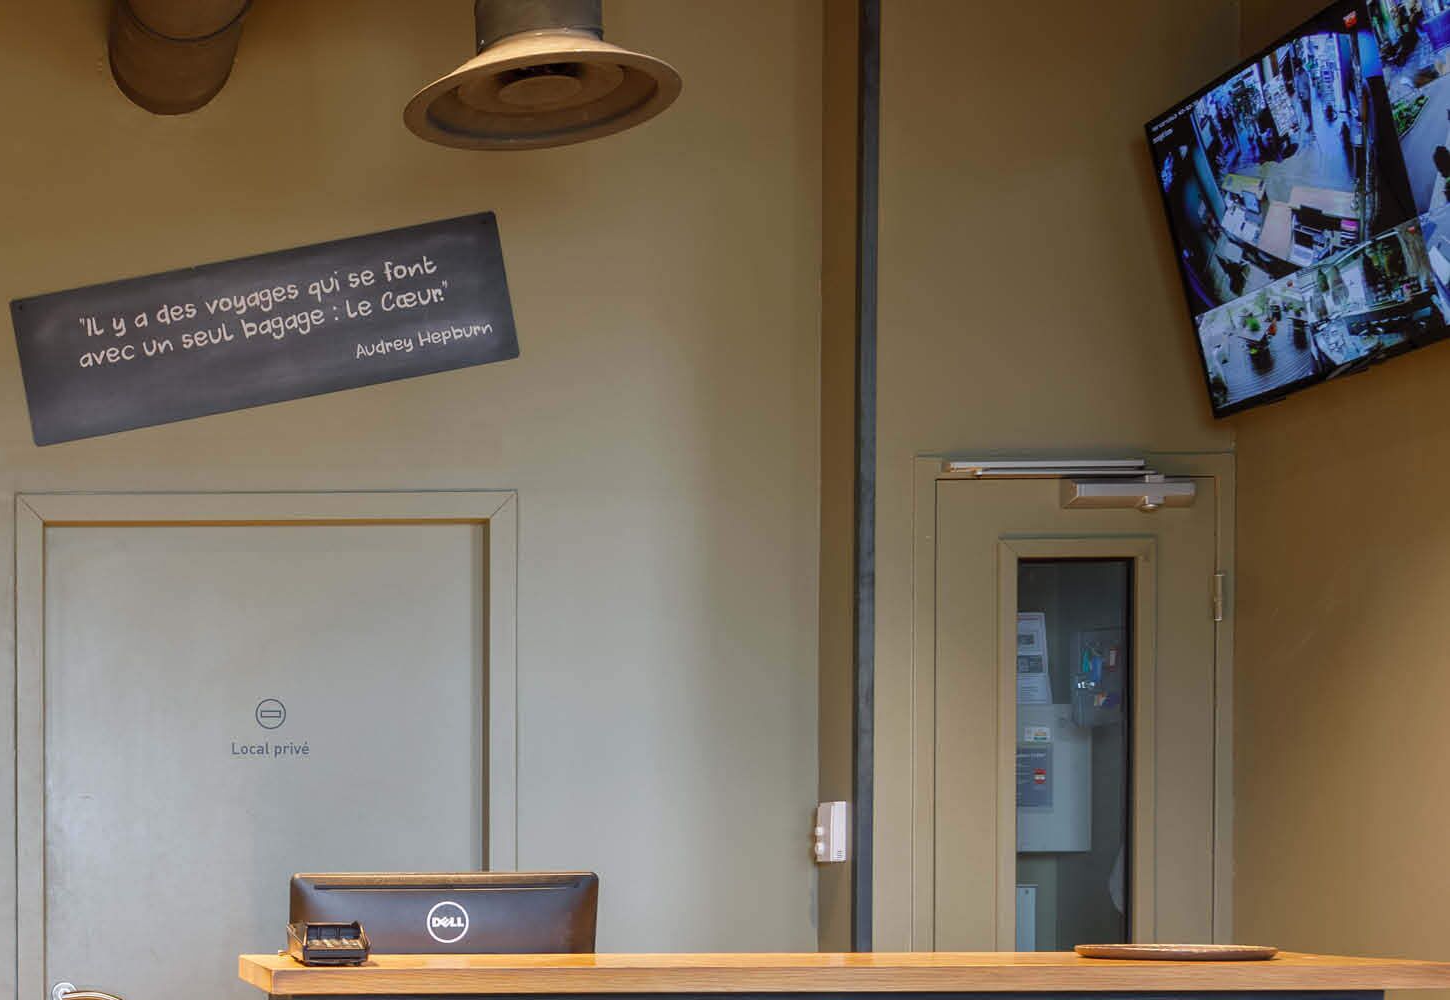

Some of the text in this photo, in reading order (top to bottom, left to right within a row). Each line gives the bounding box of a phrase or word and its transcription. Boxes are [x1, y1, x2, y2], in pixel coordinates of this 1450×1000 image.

[112, 316, 127, 337] y
[134, 311, 148, 329] a
[156, 303, 198, 325] des
[205, 283, 299, 314] voyages
[308, 270, 341, 302] qui
[348, 269, 375, 288] se
[383, 255, 438, 282] font
[78, 344, 135, 368] avec
[181, 322, 235, 349] seul
[240, 307, 326, 339] bagage
[356, 322, 494, 359] Audrey Hepburn
[231, 741, 310, 758] Local privé
[431, 917, 465, 927] DELL
